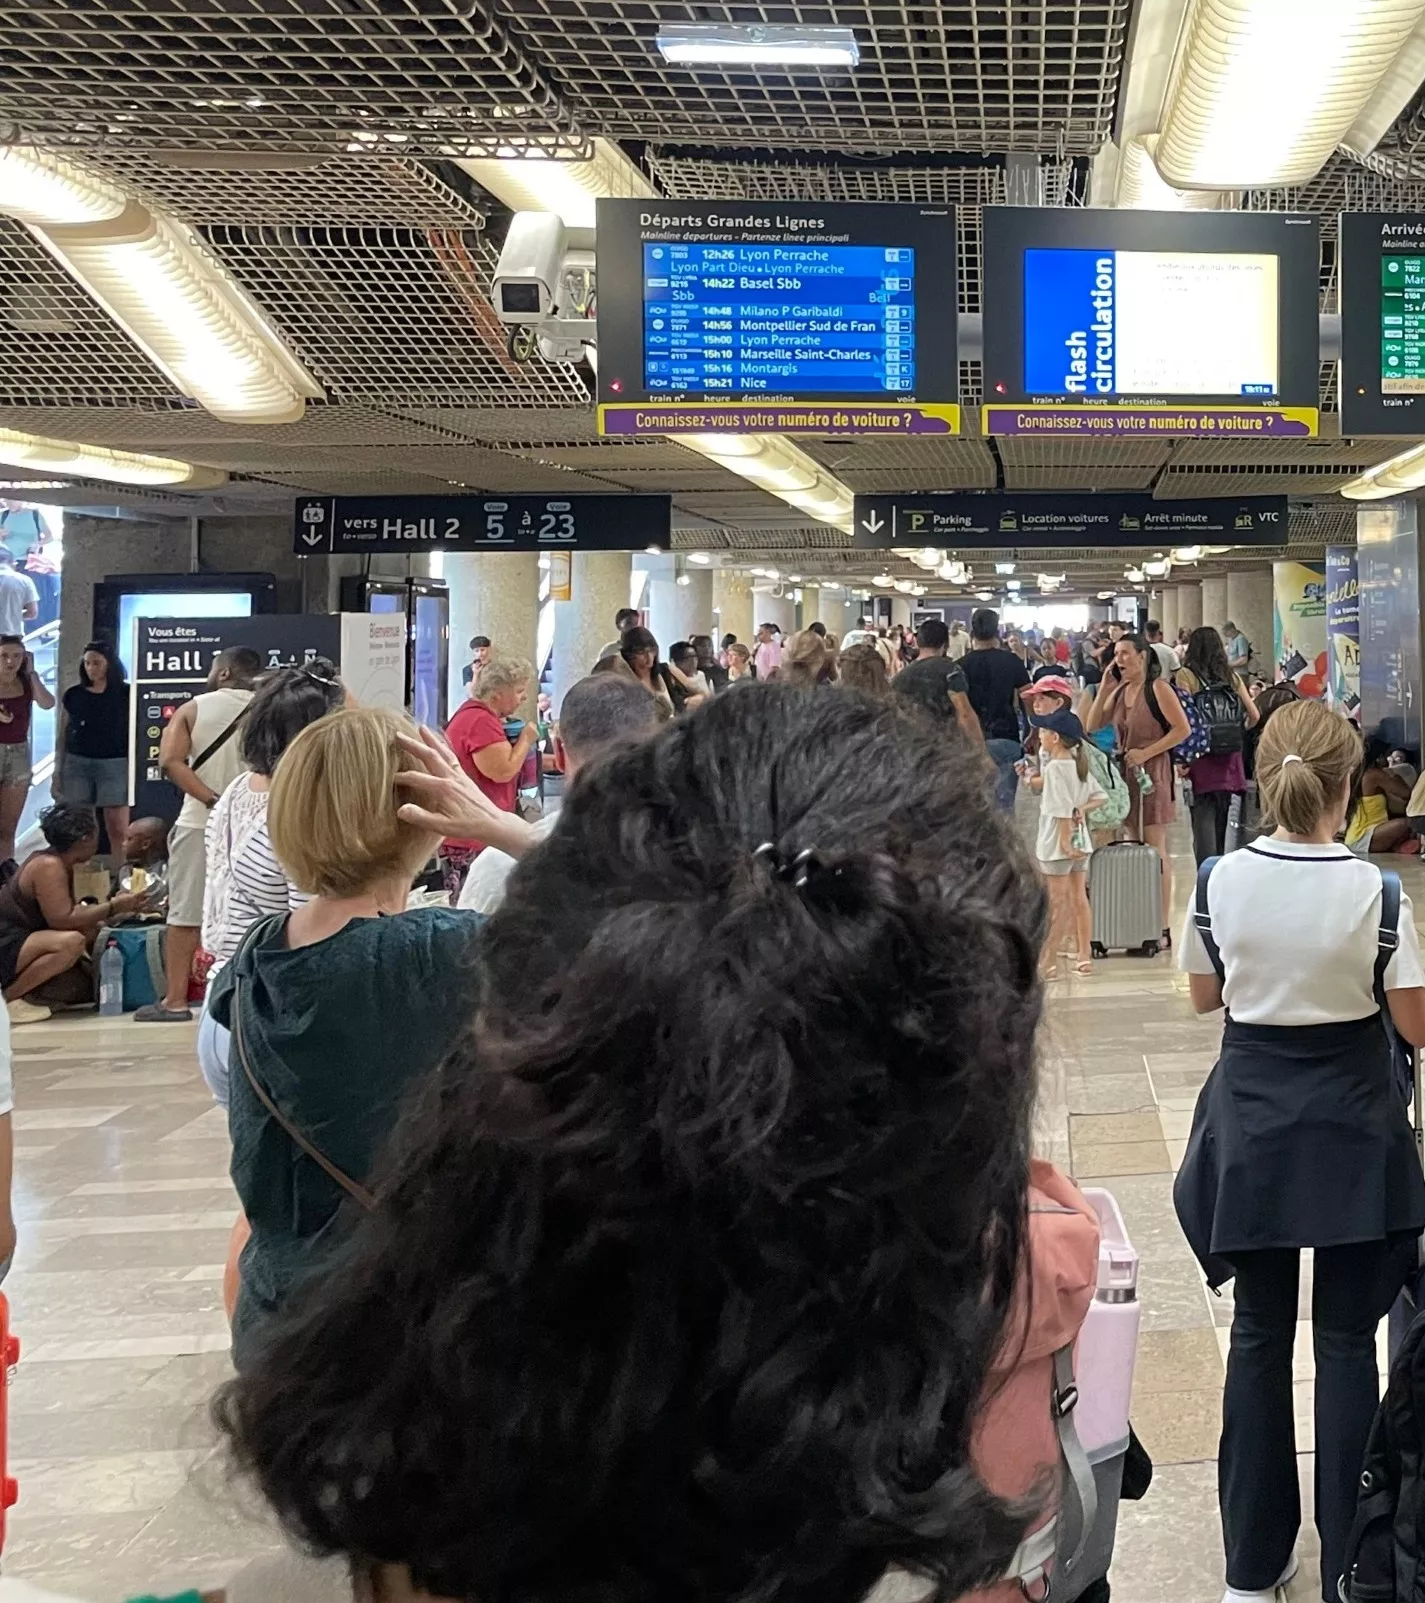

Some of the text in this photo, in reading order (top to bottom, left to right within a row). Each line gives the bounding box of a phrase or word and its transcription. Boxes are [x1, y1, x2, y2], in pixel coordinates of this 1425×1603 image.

[640, 213, 825, 231] Départs Grandes Lignes
[640, 231, 733, 242] Mainline departures
[702, 249, 829, 262] 12h26 Lyon Perrache
[671, 262, 755, 273] Lyon Part Dieu
[765, 263, 845, 275] Lyon Perrache
[702, 278, 736, 289] 14h22
[740, 277, 774, 289] Basel
[777, 278, 802, 289] Sbb
[672, 290, 695, 301] Sbb
[740, 306, 843, 317] Milano P Garibaldi
[703, 320, 876, 332] 14h56 Montpellier Sud de Fran
[1090, 257, 1113, 393] circulation
[703, 335, 821, 347] 15h00 Lyon Perrache
[703, 350, 733, 359] 15h10
[740, 349, 792, 360] Marseille
[795, 349, 871, 360] Saint-Charles
[1065, 331, 1087, 393] flash
[703, 363, 798, 376] 15h16 Montargis
[703, 378, 767, 388] 15h21 Nice
[900, 379, 910, 388] 17
[650, 394, 671, 402] train
[742, 394, 794, 402] destination
[1032, 396, 1053, 404] train
[1118, 397, 1168, 406] destination
[1262, 398, 1280, 406] voie
[1382, 398, 1402, 406] train
[636, 411, 900, 428] Connaissez-vous votre numéro de voiture
[1017, 413, 1263, 430] Connaissez-vous votre numéro de voiture
[521, 510, 531, 526] à
[911, 514, 925, 530] P
[933, 515, 972, 526] Parking
[1021, 514, 1109, 524] Location voitures
[1144, 512, 1208, 523] Arrêt minute
[1258, 512, 1279, 522] VTC
[344, 518, 460, 539] vers Hall 2
[486, 515, 504, 539] 5
[538, 514, 575, 539] 23
[148, 627, 197, 637] Vous êtes
[146, 650, 202, 671] Hall
[267, 655, 280, 667] A
[150, 691, 192, 701] Transports
